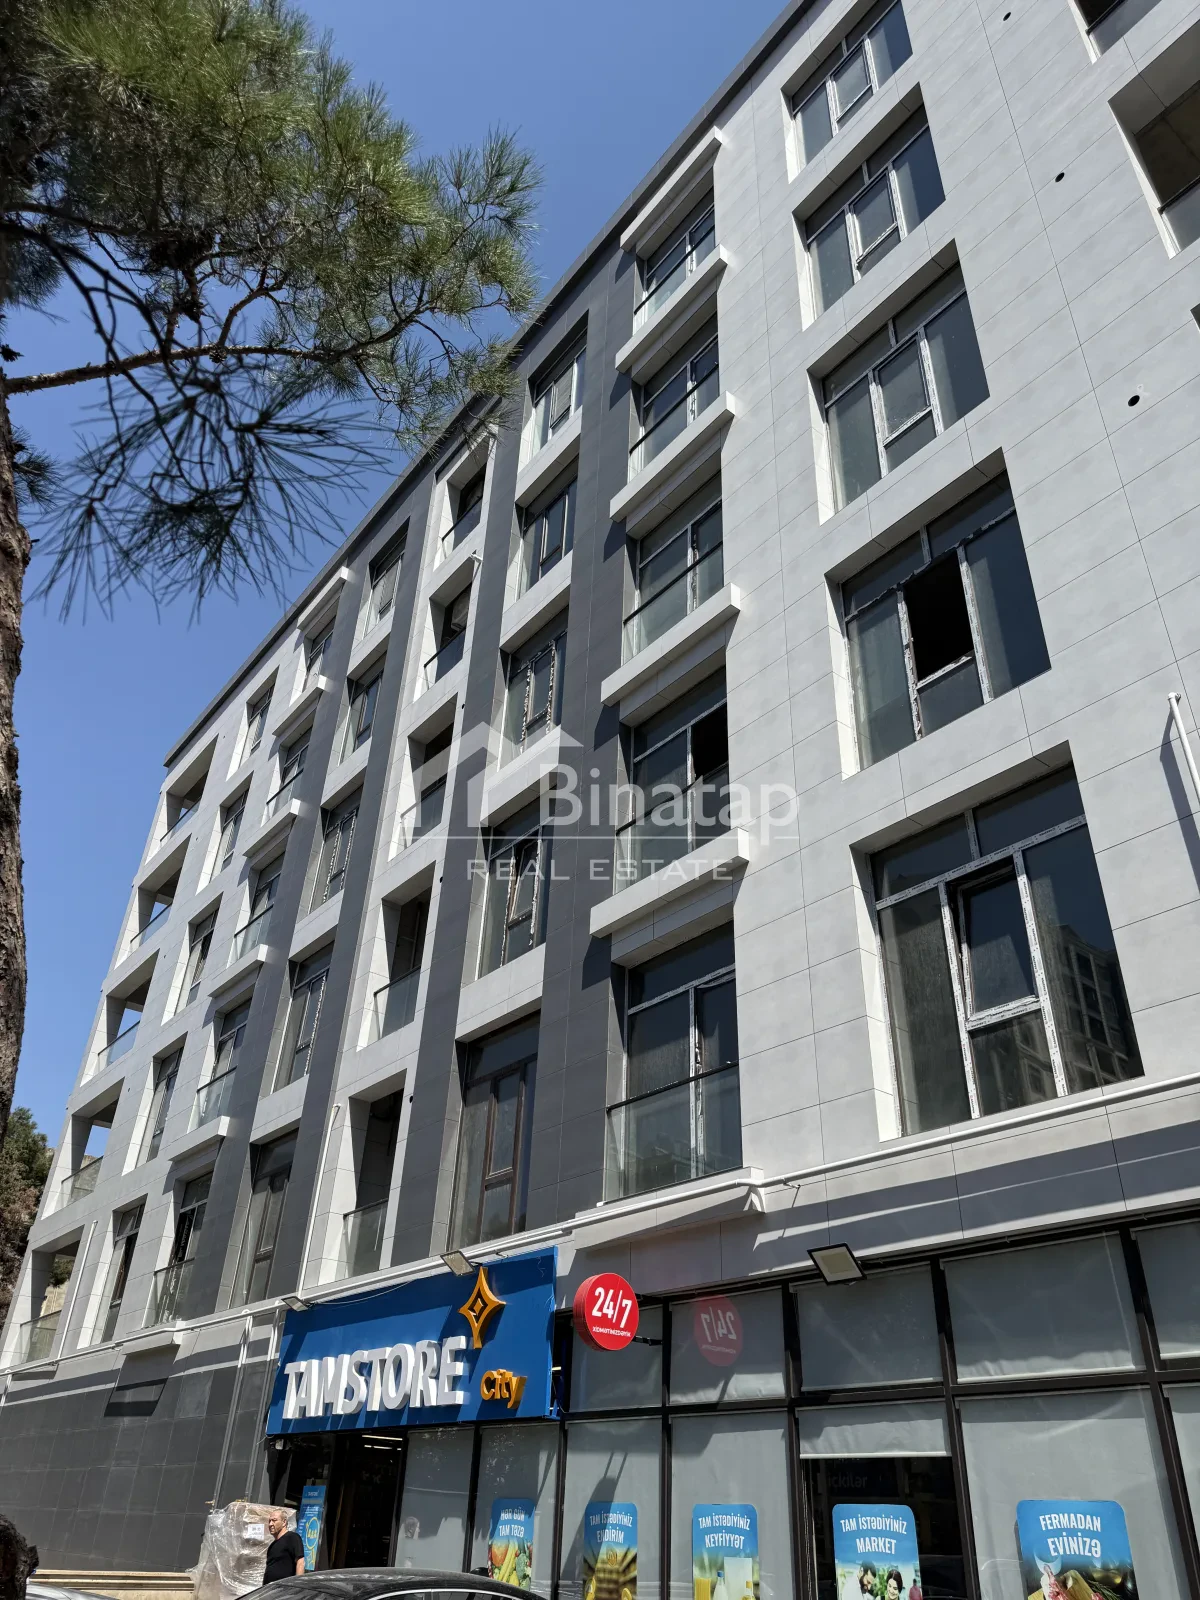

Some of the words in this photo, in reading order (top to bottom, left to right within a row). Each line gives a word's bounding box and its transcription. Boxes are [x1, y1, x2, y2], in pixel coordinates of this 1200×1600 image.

[591, 1286, 632, 1328] 24/7
[282, 1336, 467, 1419] TAMSTORE
[480, 1368, 527, 1409] city
[500, 1510, 513, 1521] HƏR
[698, 1516, 712, 1529] TAM
[712, 1512, 751, 1531] İSTƏDİYİNİZ
[840, 1517, 857, 1533] TAM
[858, 1514, 907, 1535] İSTƏDİYİNİZ
[1039, 1513, 1101, 1532] FERMADAN
[499, 1525, 510, 1537] TAM
[510, 1524, 524, 1538] TƏZƏ
[597, 1526, 625, 1544] ENDİRİM
[704, 1529, 745, 1550] KEYFİYYƏT
[856, 1536, 897, 1555] MARKET
[1047, 1532, 1102, 1558] EVİNİZƏ
